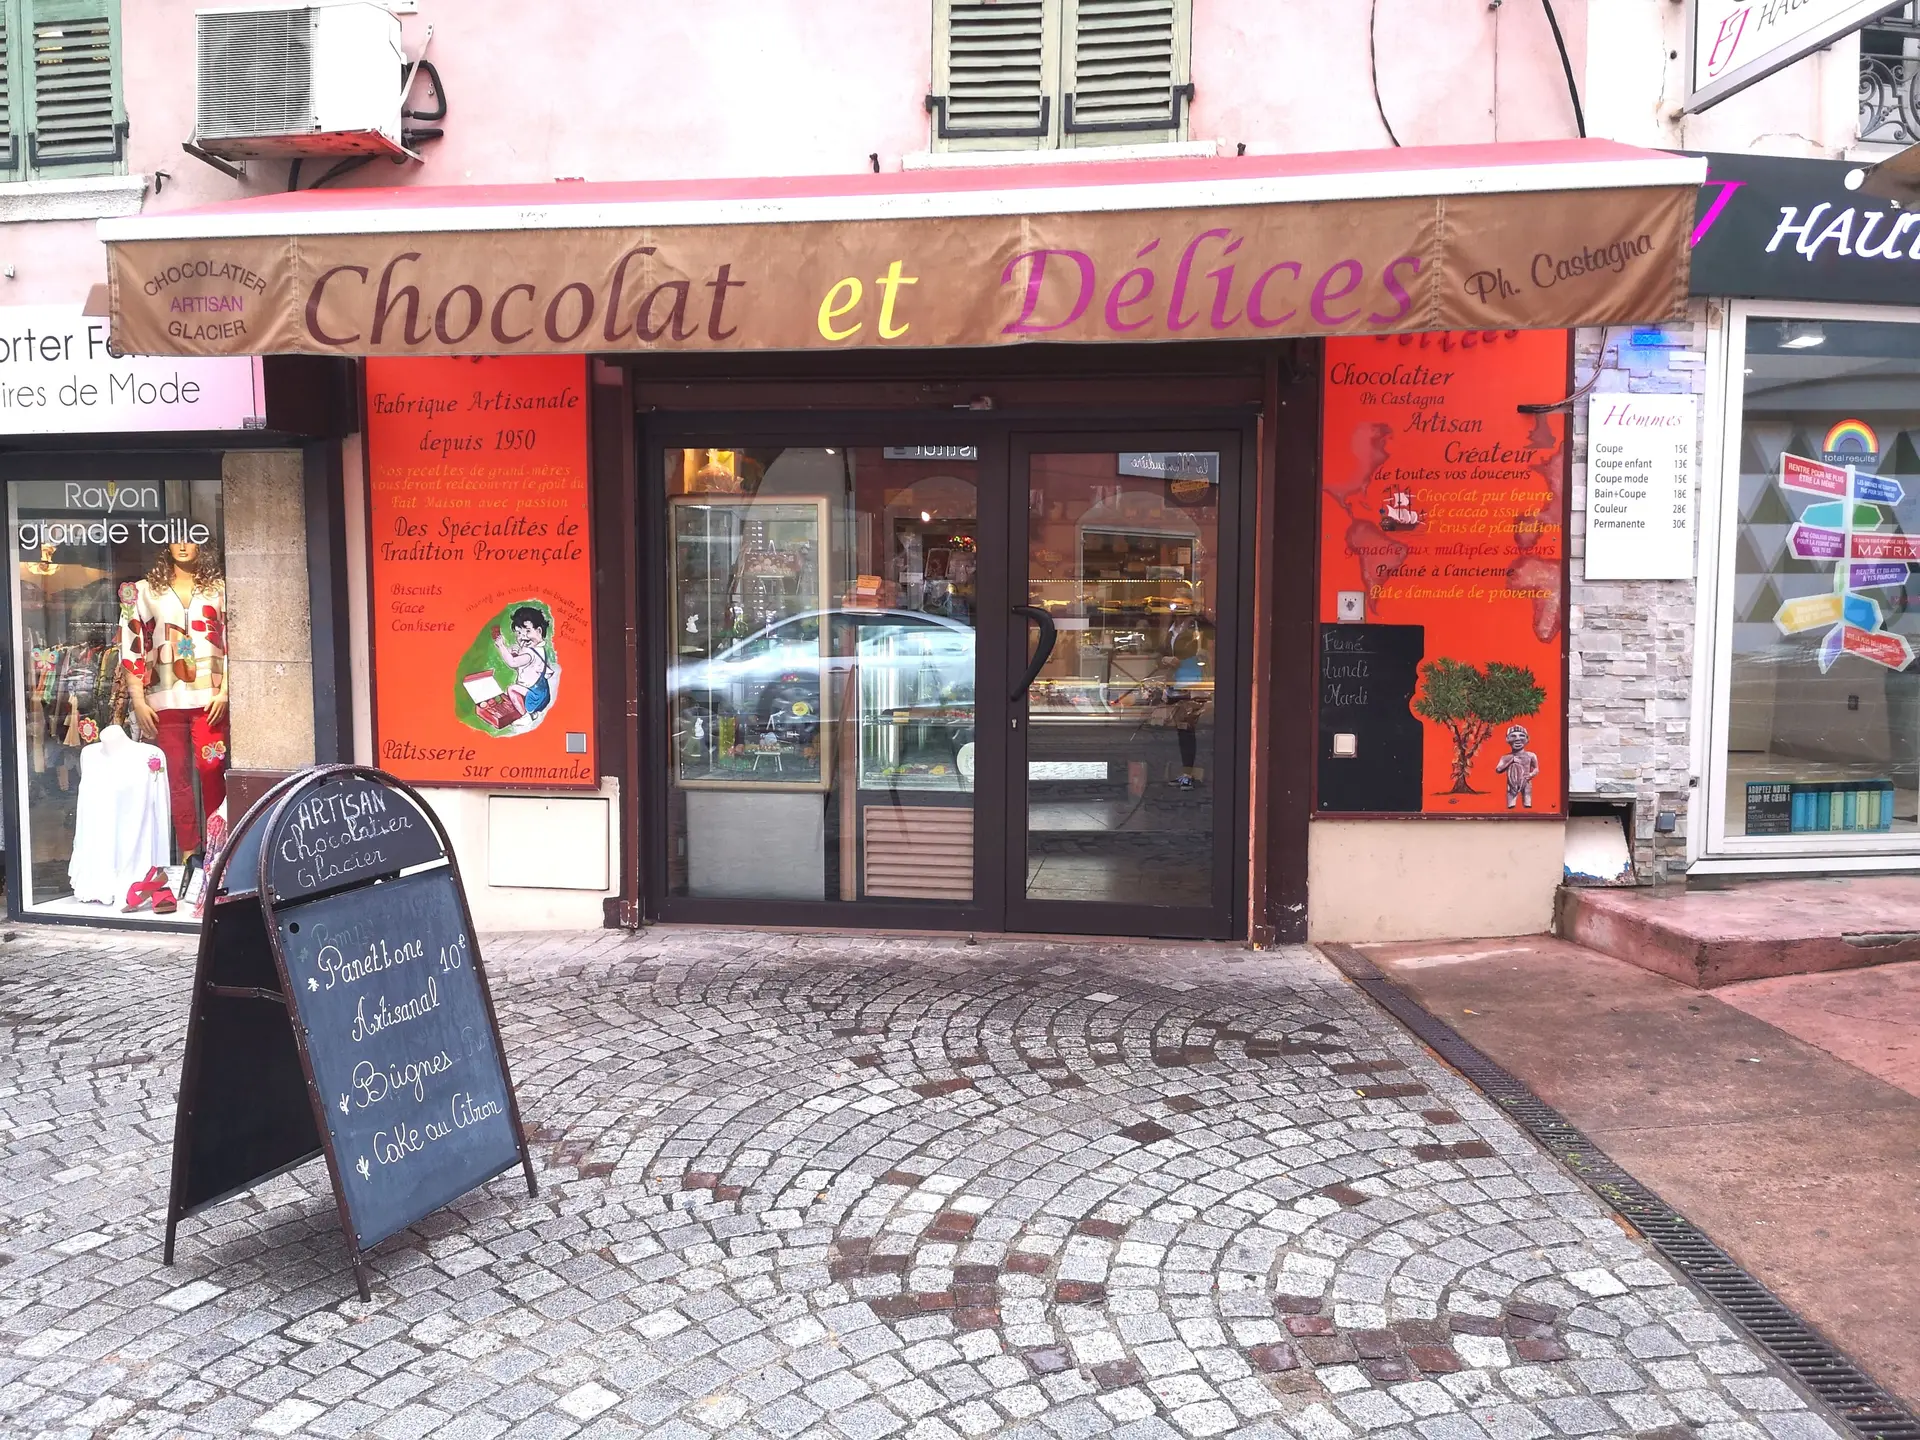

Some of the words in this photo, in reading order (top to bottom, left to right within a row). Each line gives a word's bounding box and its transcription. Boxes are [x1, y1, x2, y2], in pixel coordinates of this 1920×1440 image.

[143, 260, 267, 296] CHOCOLATIER
[1464, 268, 1521, 304] Ph.
[1531, 234, 1656, 289] Castagna
[304, 246, 747, 346] Chocolat
[817, 259, 919, 341] et
[1000, 227, 1423, 334] Délices
[170, 295, 243, 312] ARTISAN
[168, 319, 247, 341] GLACIER
[1330, 362, 1455, 386] Chocolatier
[59, 375, 98, 406] de
[110, 371, 200, 405] Mode
[373, 392, 458, 420] Fabrique
[467, 387, 579, 412] Artisanale
[1360, 391, 1377, 405] Ph
[1381, 391, 1445, 409] Castagna
[1403, 411, 1483, 433] Artisan
[1603, 403, 1684, 428] Hommes
[419, 430, 483, 459] depuis
[494, 429, 536, 450] 1950
[1444, 441, 1538, 464] Créateur
[1595, 444, 1623, 455] Coupe
[1674, 444, 1688, 454] 15€
[469, 463, 485, 476] de
[1374, 466, 1391, 481] de
[1395, 467, 1440, 480] toutes
[1443, 470, 1467, 480] vos
[1470, 465, 1531, 480] douceurs
[1595, 459, 1622, 470] Coupe
[1624, 459, 1652, 470] enfant
[1674, 459, 1687, 469] 13€
[1788, 462, 1810, 474] RENTRE
[1594, 474, 1622, 485] Coupe
[1624, 474, 1649, 485] mode
[1674, 474, 1687, 484] 15€
[64, 482, 158, 514] Rayon
[1416, 488, 1477, 502] Chocolat
[1481, 491, 1508, 506] pur
[1510, 487, 1554, 502] beurre
[1594, 489, 1646, 500] Bain+Coupe
[1673, 489, 1687, 499] 18€
[1429, 503, 1446, 518] de
[1448, 507, 1489, 518] cacao
[1492, 506, 1519, 518] issu
[1524, 503, 1540, 517] de
[1594, 504, 1627, 514] Couleur
[1672, 504, 1686, 514] 28€
[19, 518, 129, 550] grande
[138, 518, 210, 545] taille
[394, 516, 428, 537] Des
[438, 515, 548, 543] Spécialités
[556, 515, 579, 536] de
[1469, 519, 1486, 534] de
[1488, 518, 1561, 538] plantation
[1593, 519, 1645, 529] Permanente
[1672, 519, 1686, 529] 30€
[380, 540, 464, 561] Tradition
[473, 539, 582, 566] Provençale
[1434, 541, 1499, 559] multiples
[1858, 545, 1917, 557] MATRIX
[1375, 563, 1426, 577] Praliné
[1431, 564, 1439, 577] à
[1443, 563, 1515, 577] l'ancienne
[391, 583, 443, 596] Biscuits
[1467, 584, 1484, 598] de
[391, 601, 425, 614] Glace
[391, 618, 455, 632] Confiserie
[1324, 683, 1369, 706] Mardi
[382, 738, 476, 761] Pâtisserie
[462, 763, 494, 778] sur
[500, 759, 591, 780] commande
[297, 849, 387, 888] Glacier
[318, 939, 424, 990] Panettone
[352, 976, 441, 1042] Artisanal
[425, 1120, 452, 1141] au
[452, 1092, 503, 1129] Citron
